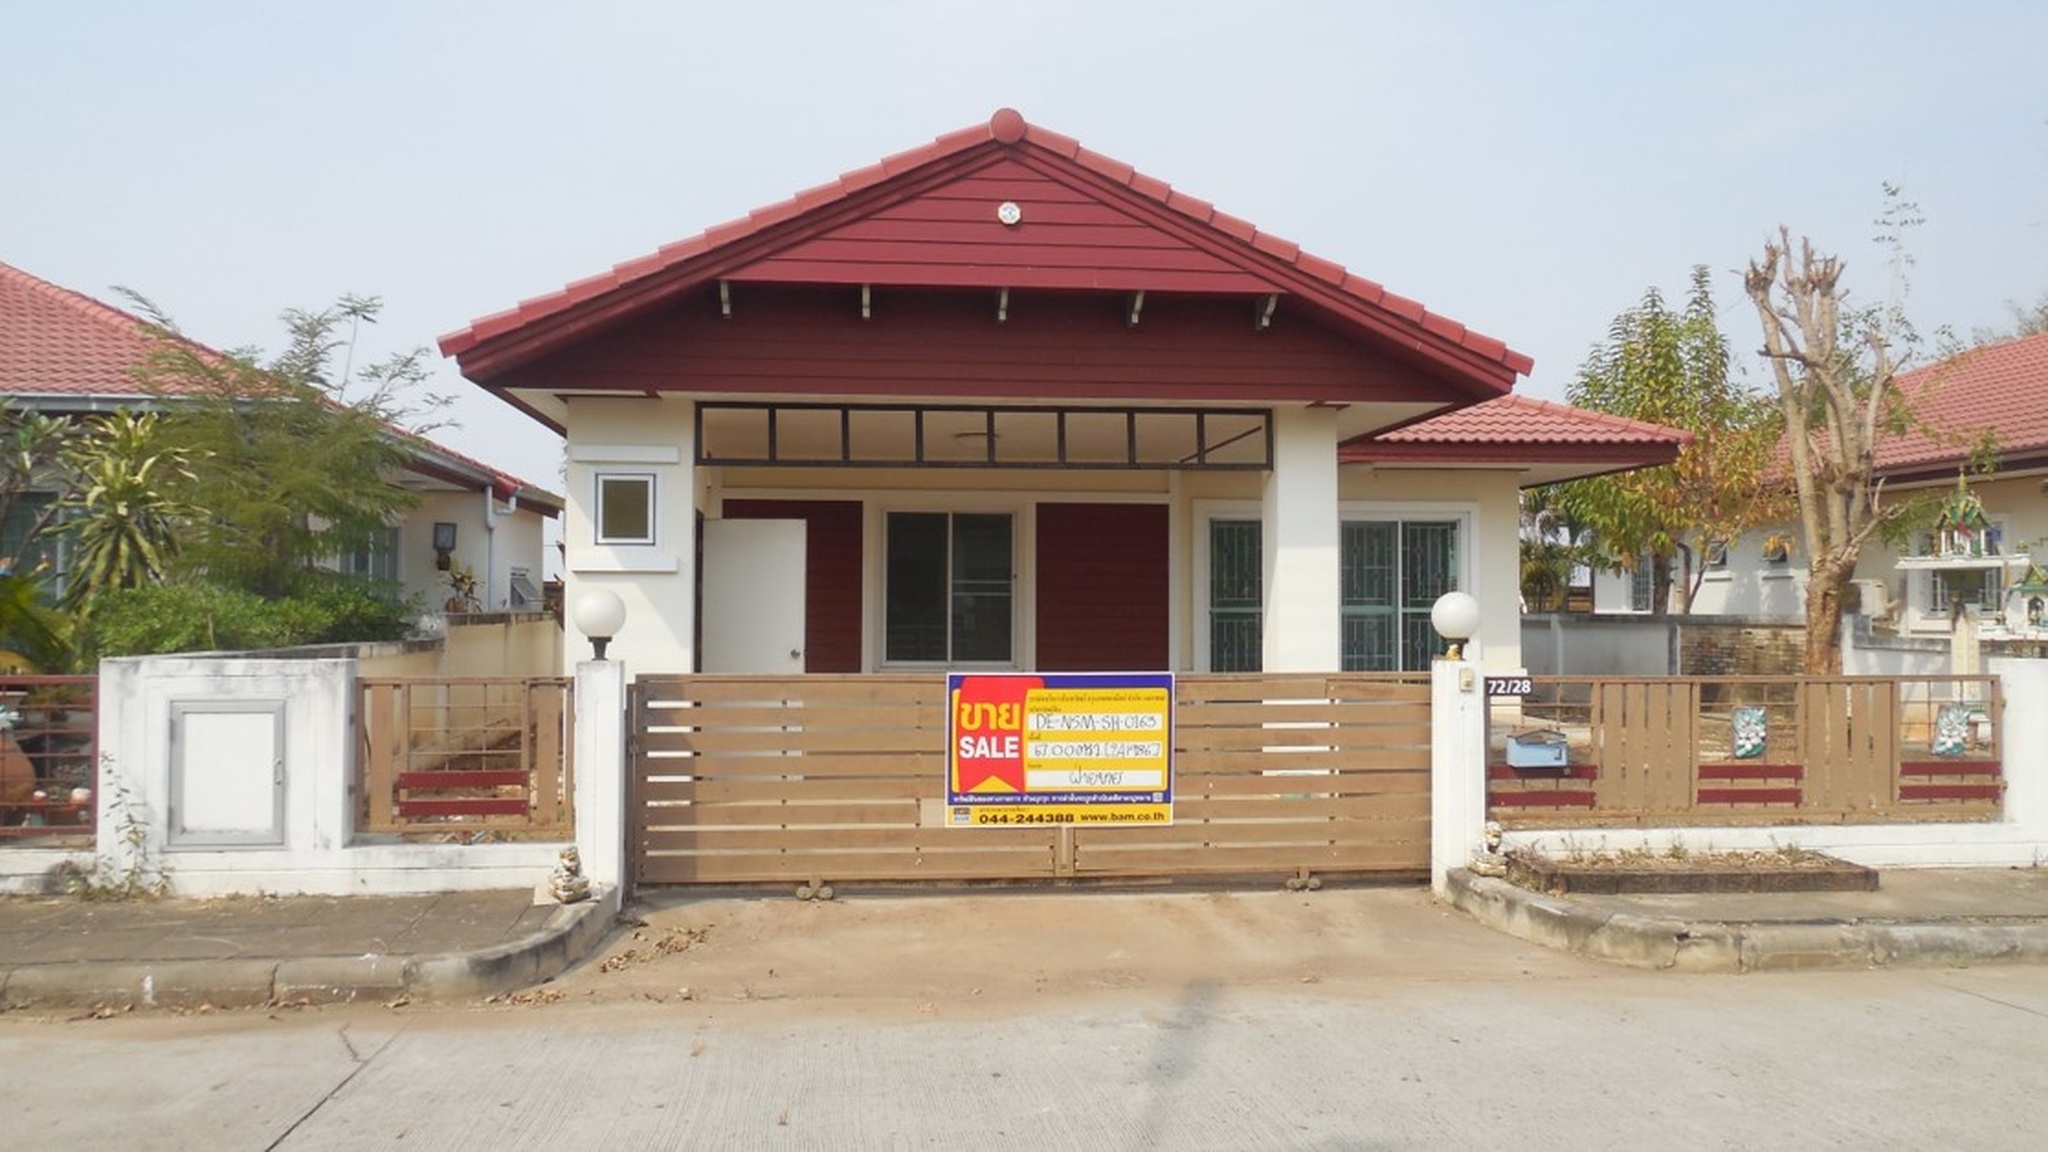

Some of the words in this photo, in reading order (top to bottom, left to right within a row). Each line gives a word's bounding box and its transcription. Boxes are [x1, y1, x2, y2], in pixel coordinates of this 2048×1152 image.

[1487, 680, 1531, 694] 72/28
[961, 702, 1021, 731] ขาย
[959, 735, 1020, 759] SALE
[979, 813, 1075, 825] 044-244388
[1080, 811, 1165, 822] www.bam.co.th
